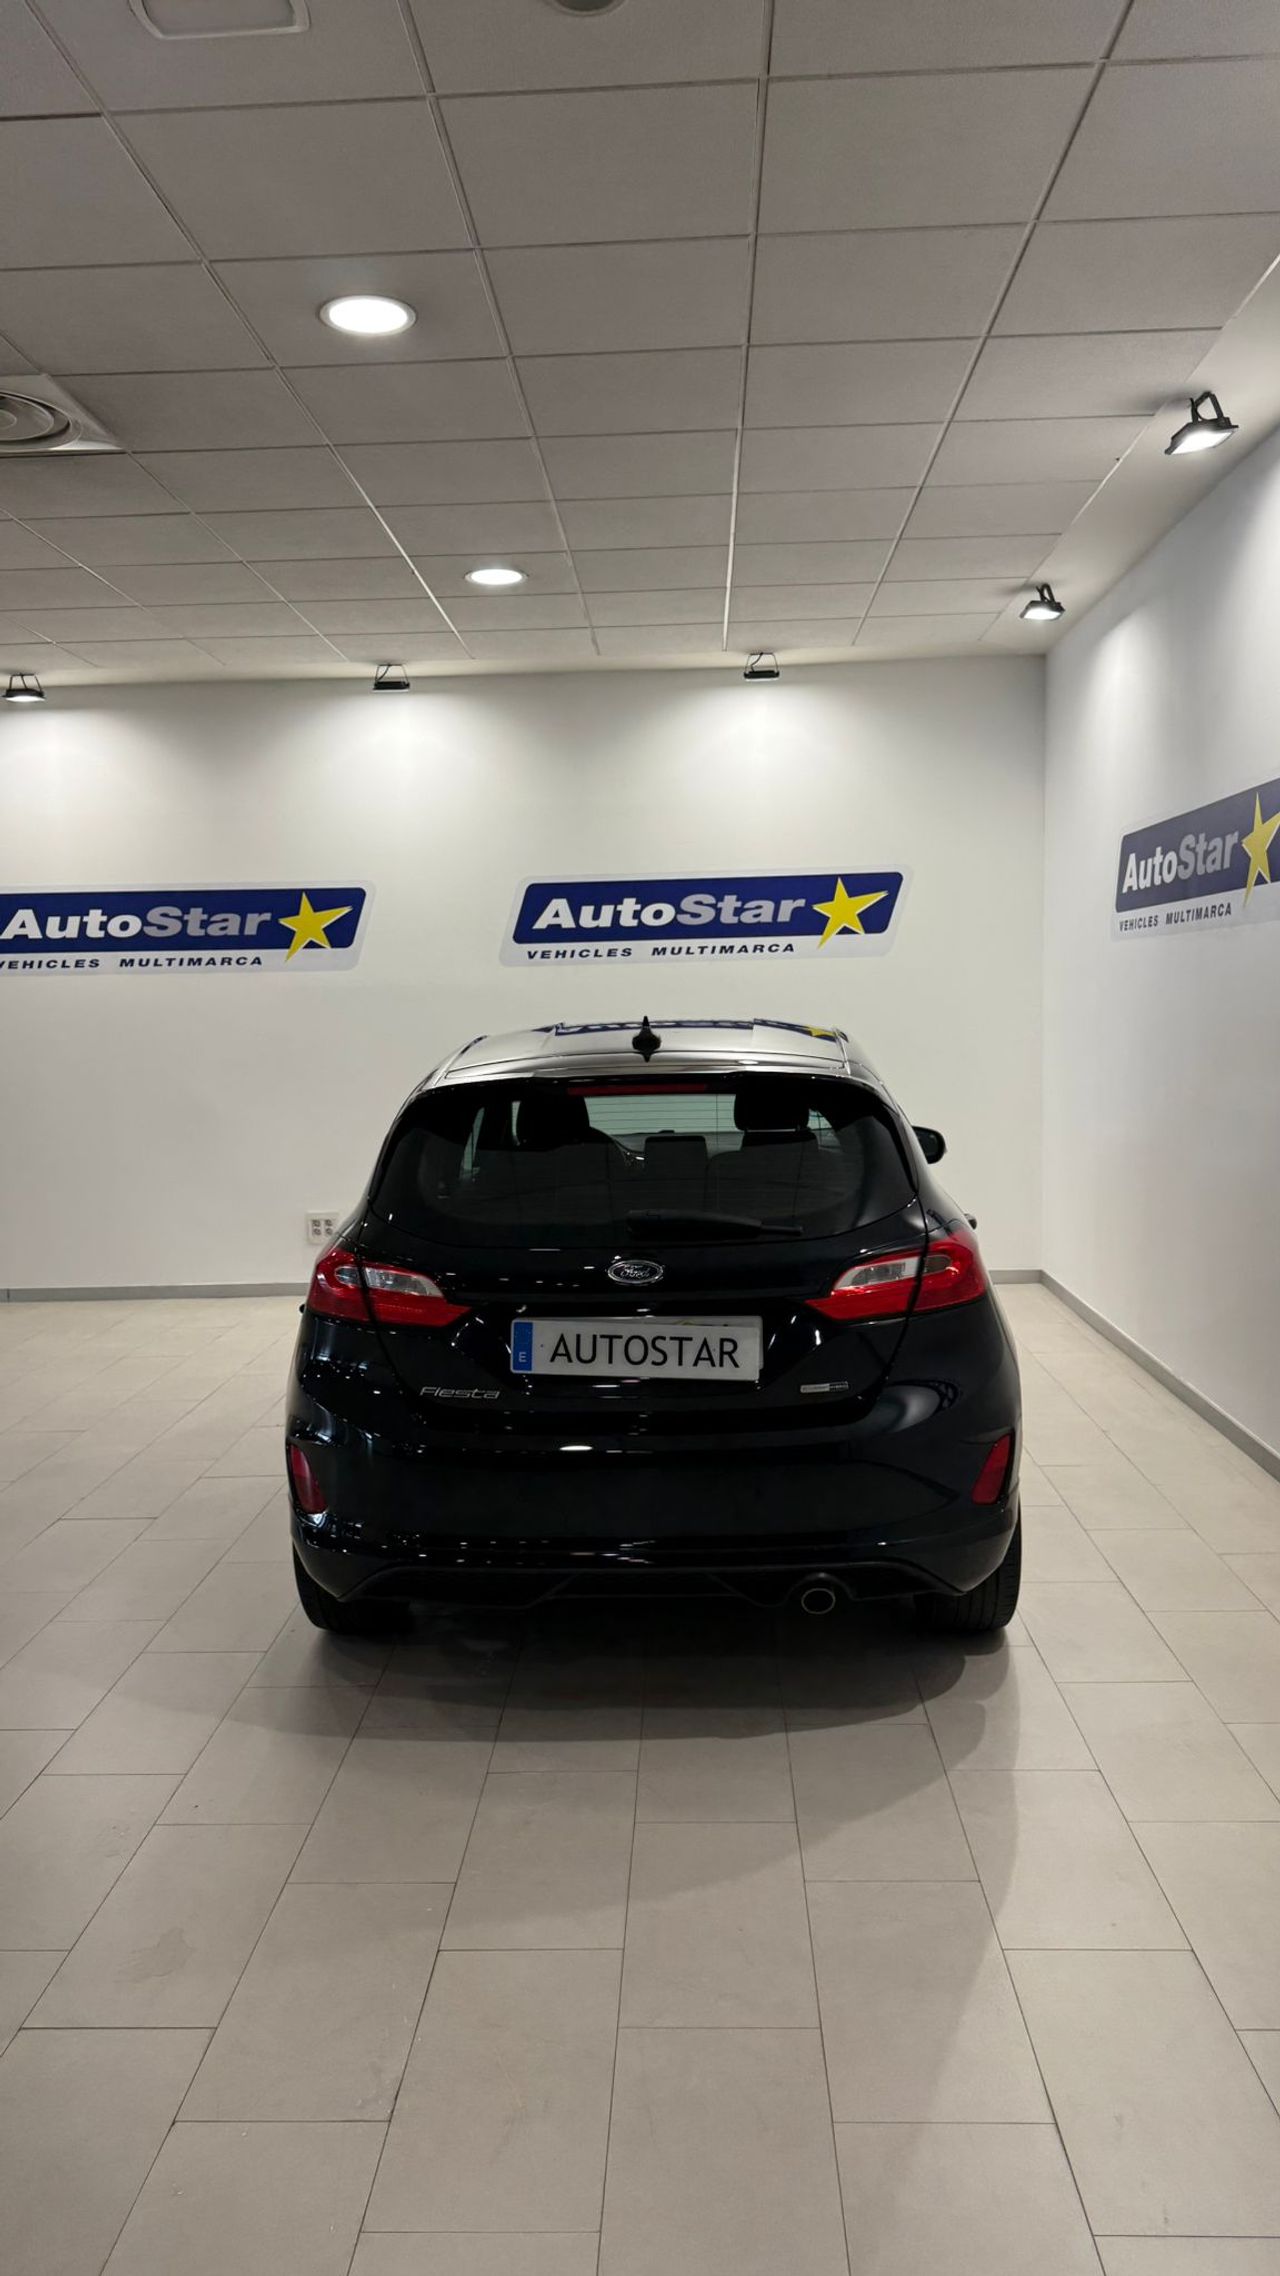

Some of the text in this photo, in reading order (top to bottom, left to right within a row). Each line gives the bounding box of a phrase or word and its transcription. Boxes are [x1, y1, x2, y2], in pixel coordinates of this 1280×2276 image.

[1122, 831, 1239, 894] AutoStar
[0, 906, 271, 939] AutoStar
[533, 895, 805, 929] AutoStar
[1119, 902, 1232, 932] VEHICLES MULTIMARCA
[119, 956, 263, 968] MULTIMARCA
[527, 943, 795, 960] VEHICLES MULTIMARCA
[518, 1352, 527, 1363] E
[550, 1333, 740, 1369] AUTOSTAR
[420, 1386, 500, 1399] Fiesta
